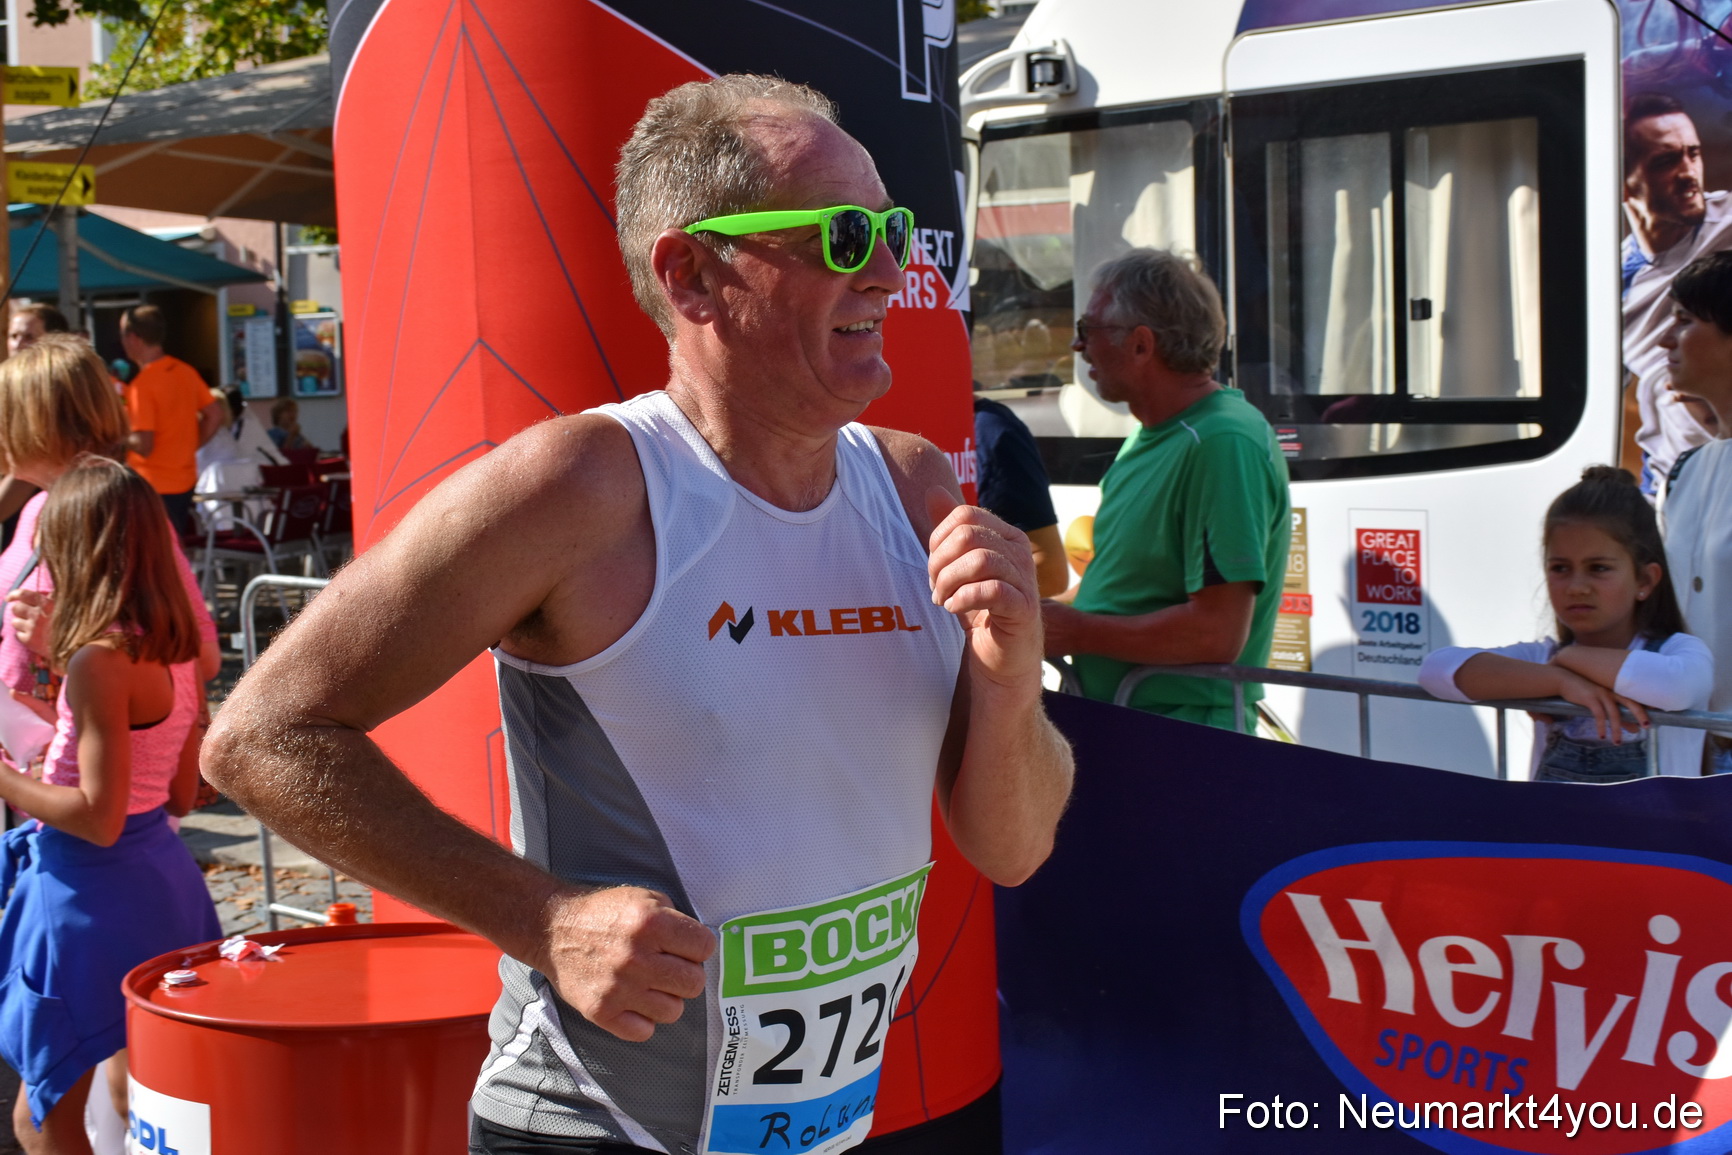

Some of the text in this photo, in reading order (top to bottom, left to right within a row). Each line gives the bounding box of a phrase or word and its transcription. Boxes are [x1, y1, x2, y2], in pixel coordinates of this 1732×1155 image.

[1361, 531, 1416, 550] GREAT
[1362, 549, 1417, 568] PLACE
[1393, 567, 1417, 585] TO
[767, 606, 922, 637] KLEBL
[1361, 609, 1421, 635] 2018
[750, 886, 917, 979] BOCK
[1285, 892, 1732, 1091] Hervis
[1374, 1027, 1529, 1098] SPORTS
